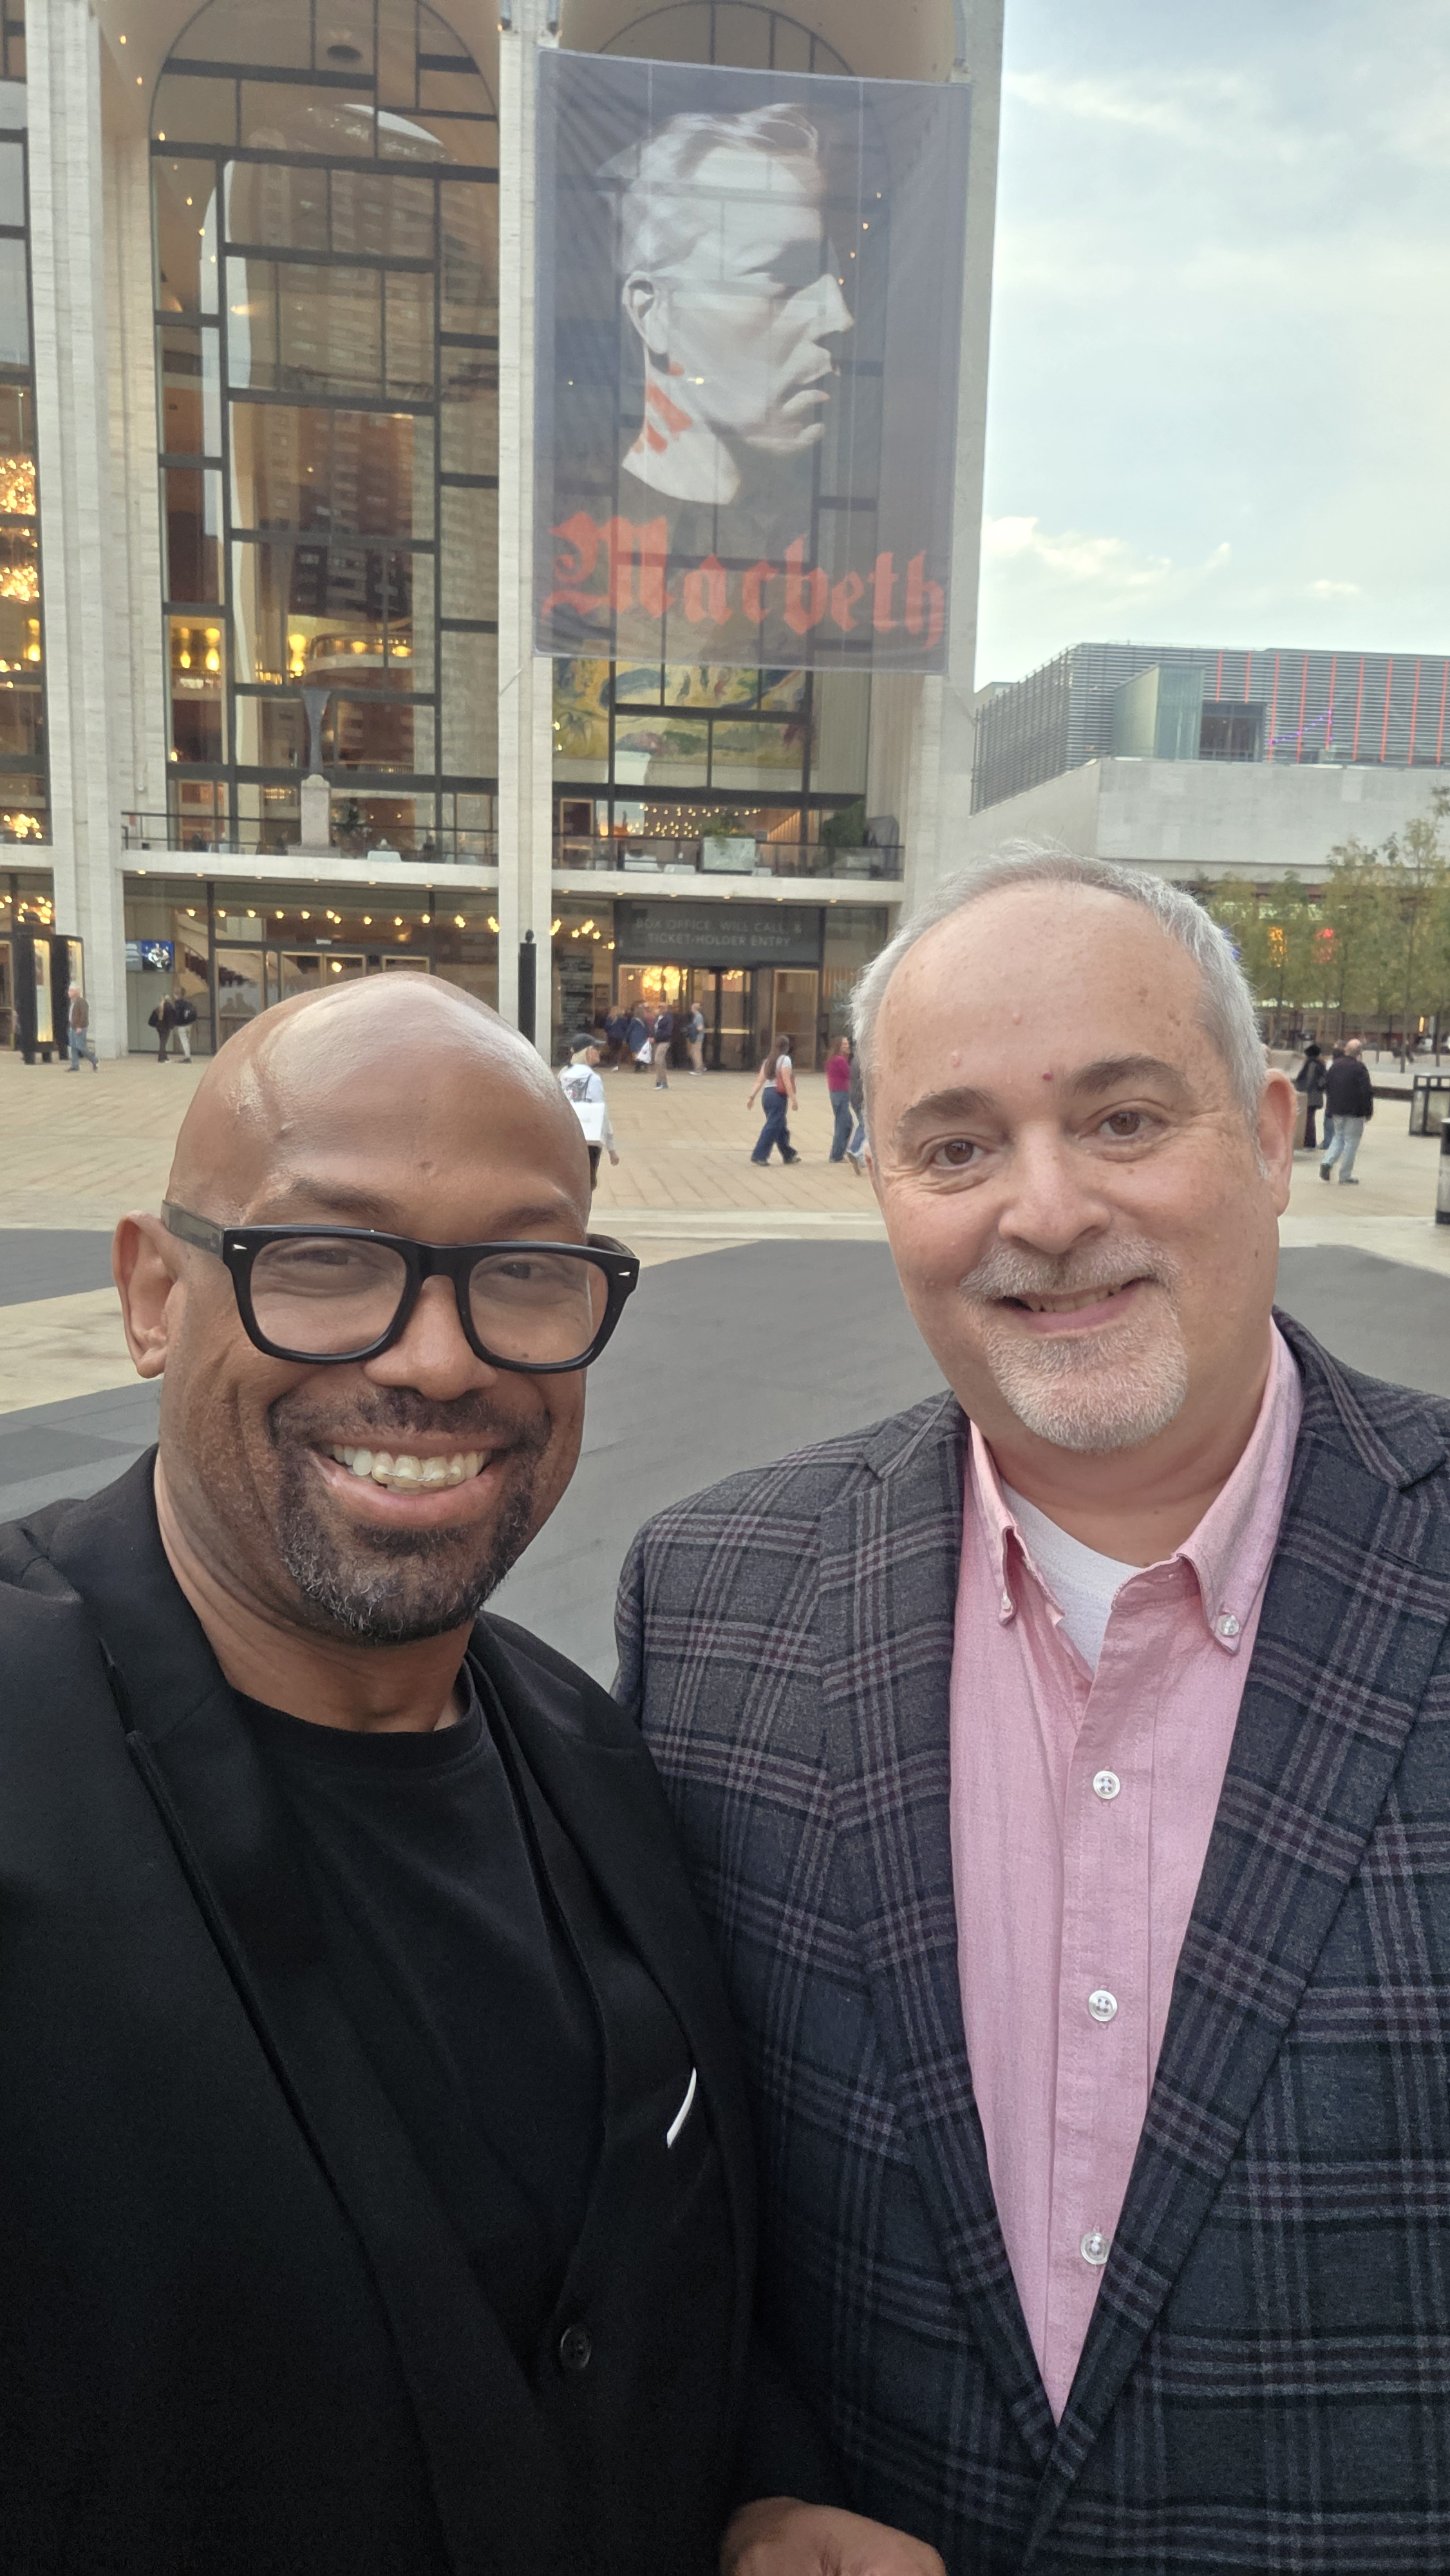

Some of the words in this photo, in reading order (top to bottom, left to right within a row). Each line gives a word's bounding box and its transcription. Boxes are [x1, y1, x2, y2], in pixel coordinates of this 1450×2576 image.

[542, 511, 946, 650] Macbeth
[635, 918, 662, 930] BOX
[751, 935, 792, 948] ENTRY
